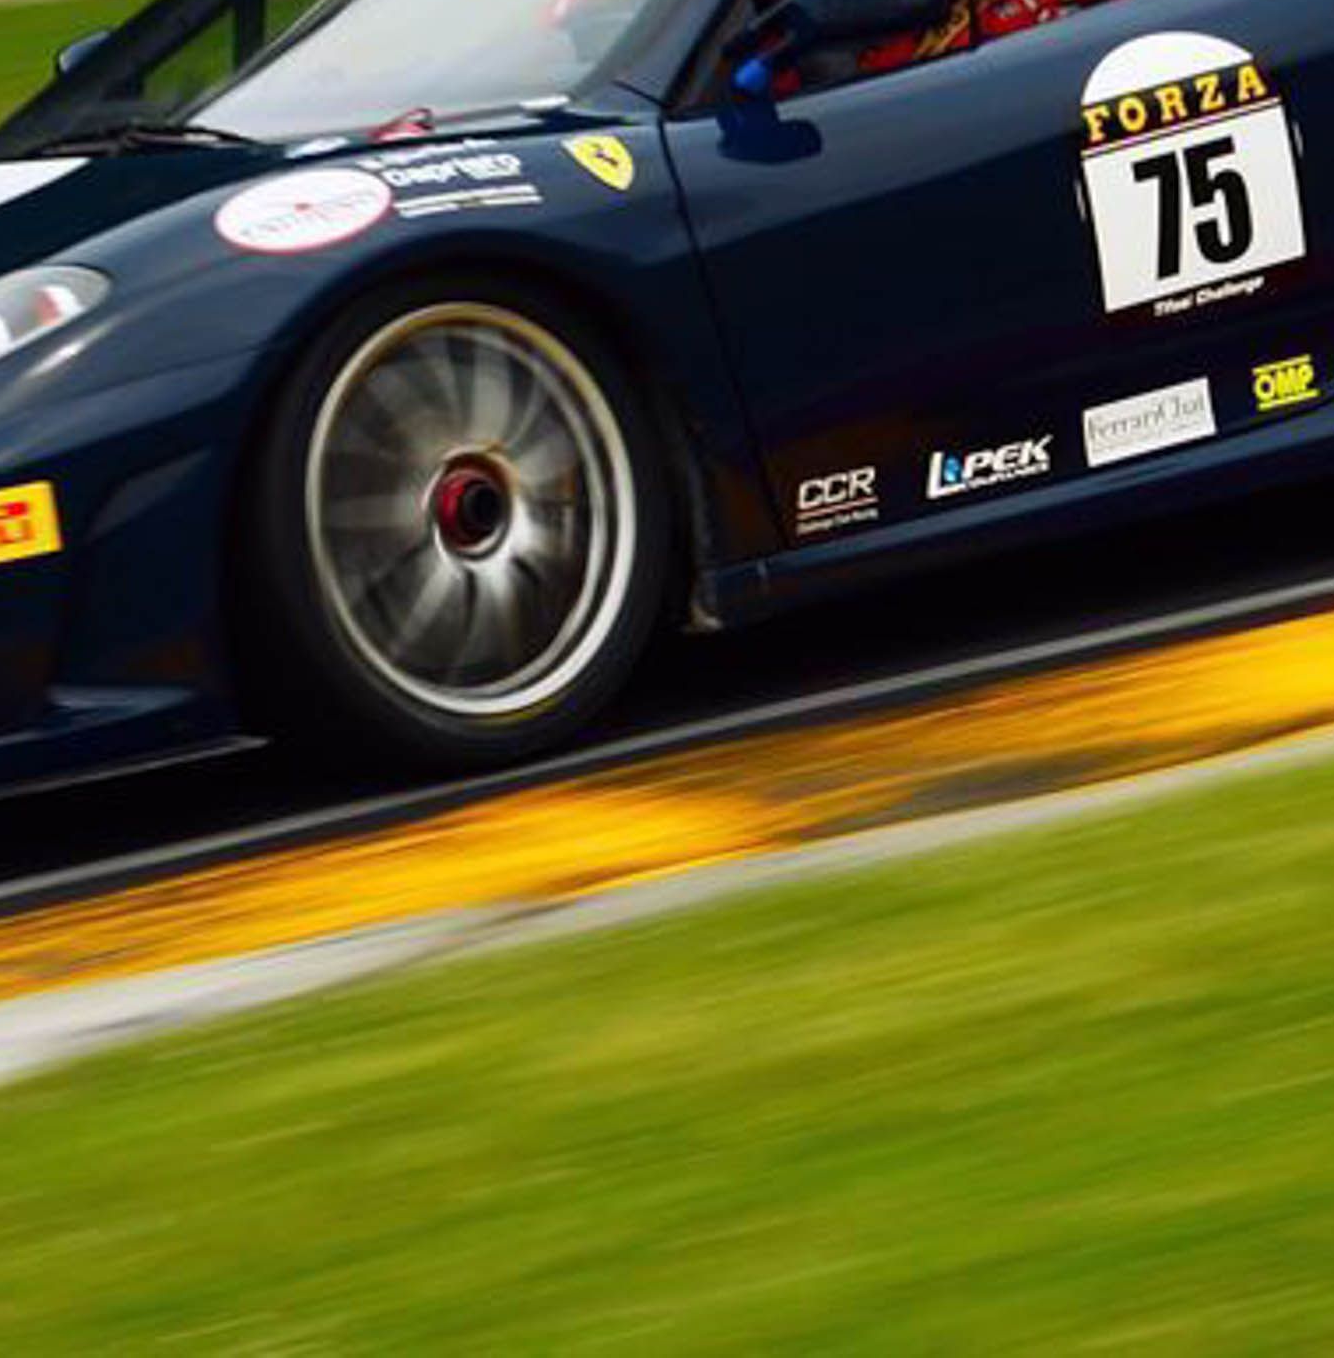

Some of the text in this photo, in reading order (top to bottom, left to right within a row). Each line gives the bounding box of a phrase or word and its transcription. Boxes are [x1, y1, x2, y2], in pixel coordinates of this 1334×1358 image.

[1082, 64, 1267, 143] FORZA
[1131, 135, 1254, 281] 75
[1254, 364, 1315, 402] OMP
[798, 466, 876, 510] CCR
